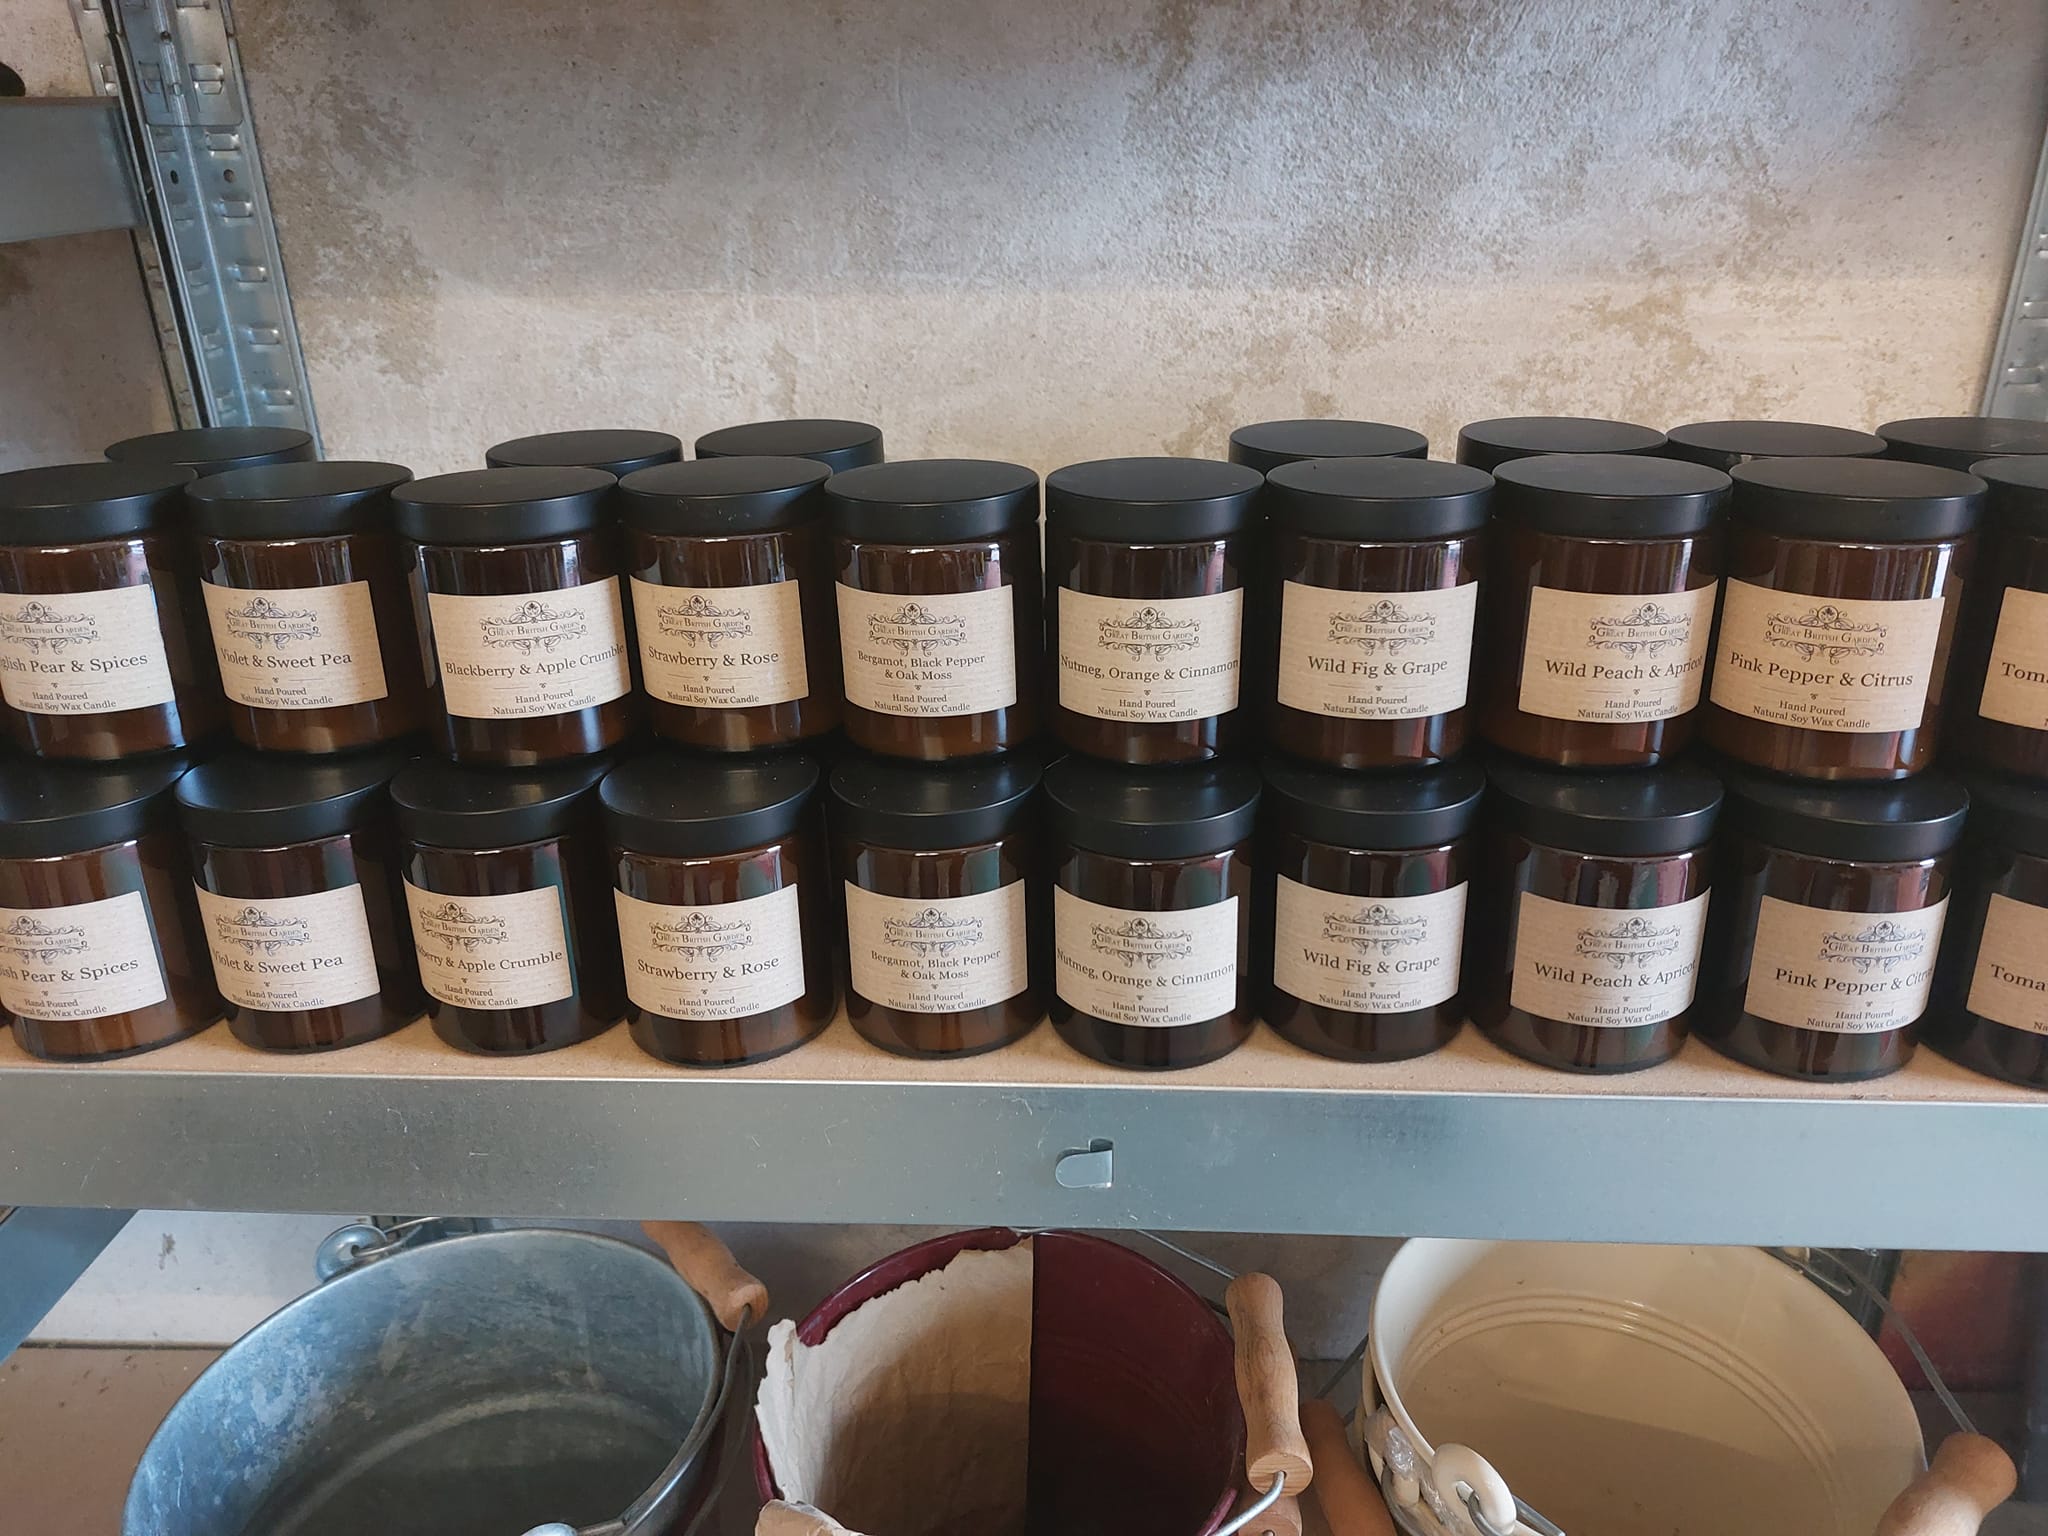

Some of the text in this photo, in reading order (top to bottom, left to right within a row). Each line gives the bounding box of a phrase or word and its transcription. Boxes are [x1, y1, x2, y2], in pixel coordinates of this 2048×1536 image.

[2, 654, 148, 673] glish Pear & Spices
[221, 648, 352, 669] Violet & Sweet Pea
[445, 644, 625, 679] Blackberry & Apple Crumble
[649, 645, 779, 670] Strawberry & Rose
[858, 650, 985, 669] Bergamot, Black Pepper
[884, 670, 952, 680] & Oak Moss
[1061, 655, 1239, 683] Nutmeg, Orange & Cinnamon
[1307, 655, 1448, 679] Wild Fig & Grape
[1545, 659, 1586, 678] Wild
[1592, 665, 1644, 679] Peach
[1649, 665, 1661, 678] &
[1730, 652, 1913, 687] Pink Pepper & Citrus
[2002, 662, 2048, 684] Tom
[33, 692, 88, 701] Hand Poured
[254, 686, 307, 696] Hand Poured
[515, 689, 574, 704] Hand Poured
[683, 685, 735, 694] Hand Poured
[492, 695, 596, 716] Natural Soy Wax Candle
[892, 693, 947, 703] Hand Poured
[1119, 699, 1176, 708] Hand Poured
[1347, 695, 1407, 705] Hand Poured
[1605, 698, 1662, 709] Hand Poured
[1097, 706, 1198, 720] Natural Soy Wax Candle
[1779, 700, 1846, 716] Hand Poured
[1753, 705, 1870, 729] Natural Soy Wax Candle
[244, 960, 255, 972] &
[258, 961, 307, 973] Sweet
[312, 957, 343, 970] Pea
[445, 956, 455, 968] &
[458, 960, 495, 973] Apple
[499, 950, 563, 970] Crumble
[871, 950, 1000, 969] Bergamot, Black Pepper
[1303, 949, 1440, 976] Wild Fig & Grape
[22, 969, 55, 983] Pear
[61, 970, 75, 982] &
[80, 959, 139, 981] Spices
[637, 957, 780, 983] Strawberry & Rose
[900, 970, 969, 980] & Oak Moss
[1056, 949, 1234, 989] Nutmeg, Orange & Cinnamon
[1534, 962, 1574, 983] Wild
[1581, 972, 1632, 988] Peach
[1638, 974, 1651, 986] &
[1775, 967, 1817, 988] Pink
[1823, 977, 1887, 995] Pepper
[1891, 977, 1902, 989] &
[246, 990, 298, 999] Hand Poured
[444, 984, 493, 996] Hand Poured
[908, 992, 964, 1001] Hand Poured
[1343, 989, 1401, 999] Hand Poured
[25, 999, 78, 1007] Hand Poured
[660, 1002, 760, 1018] Natural Soy Wax Candle
[678, 997, 735, 1007] Hand Poured
[1112, 1002, 1169, 1013] Hand Poured
[1594, 1004, 1652, 1015] Hand Poured
[1092, 1004, 1192, 1023] Natural Soy Wax Candle
[1567, 1009, 1669, 1026] Natural Soy Wax Candle
[1835, 1009, 1894, 1020] Hand Poured
